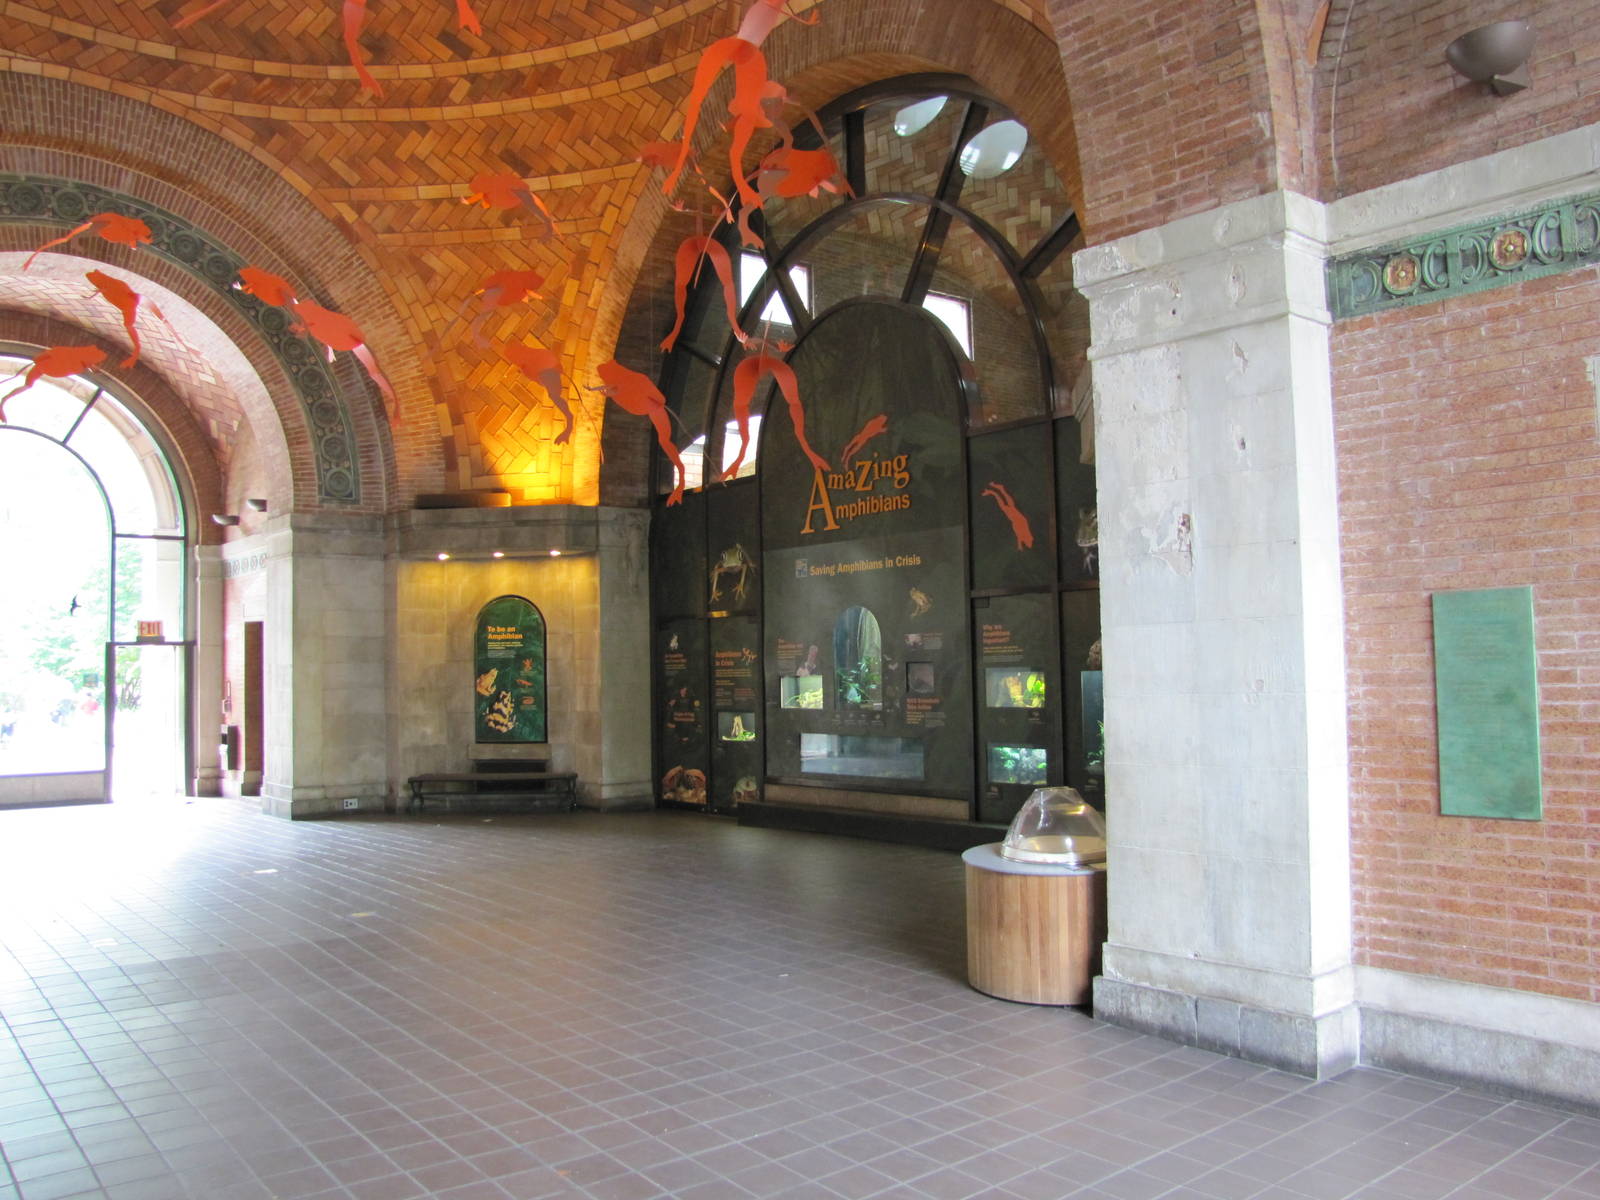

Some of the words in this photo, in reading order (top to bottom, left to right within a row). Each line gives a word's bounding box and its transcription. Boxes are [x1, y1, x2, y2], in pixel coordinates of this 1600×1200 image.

[809, 564, 836, 577] Saving
[837, 559, 883, 574] Amphibians
[885, 556, 894, 568] in
[895, 554, 921, 567] Crisis
[139, 621, 162, 635] EXIT
